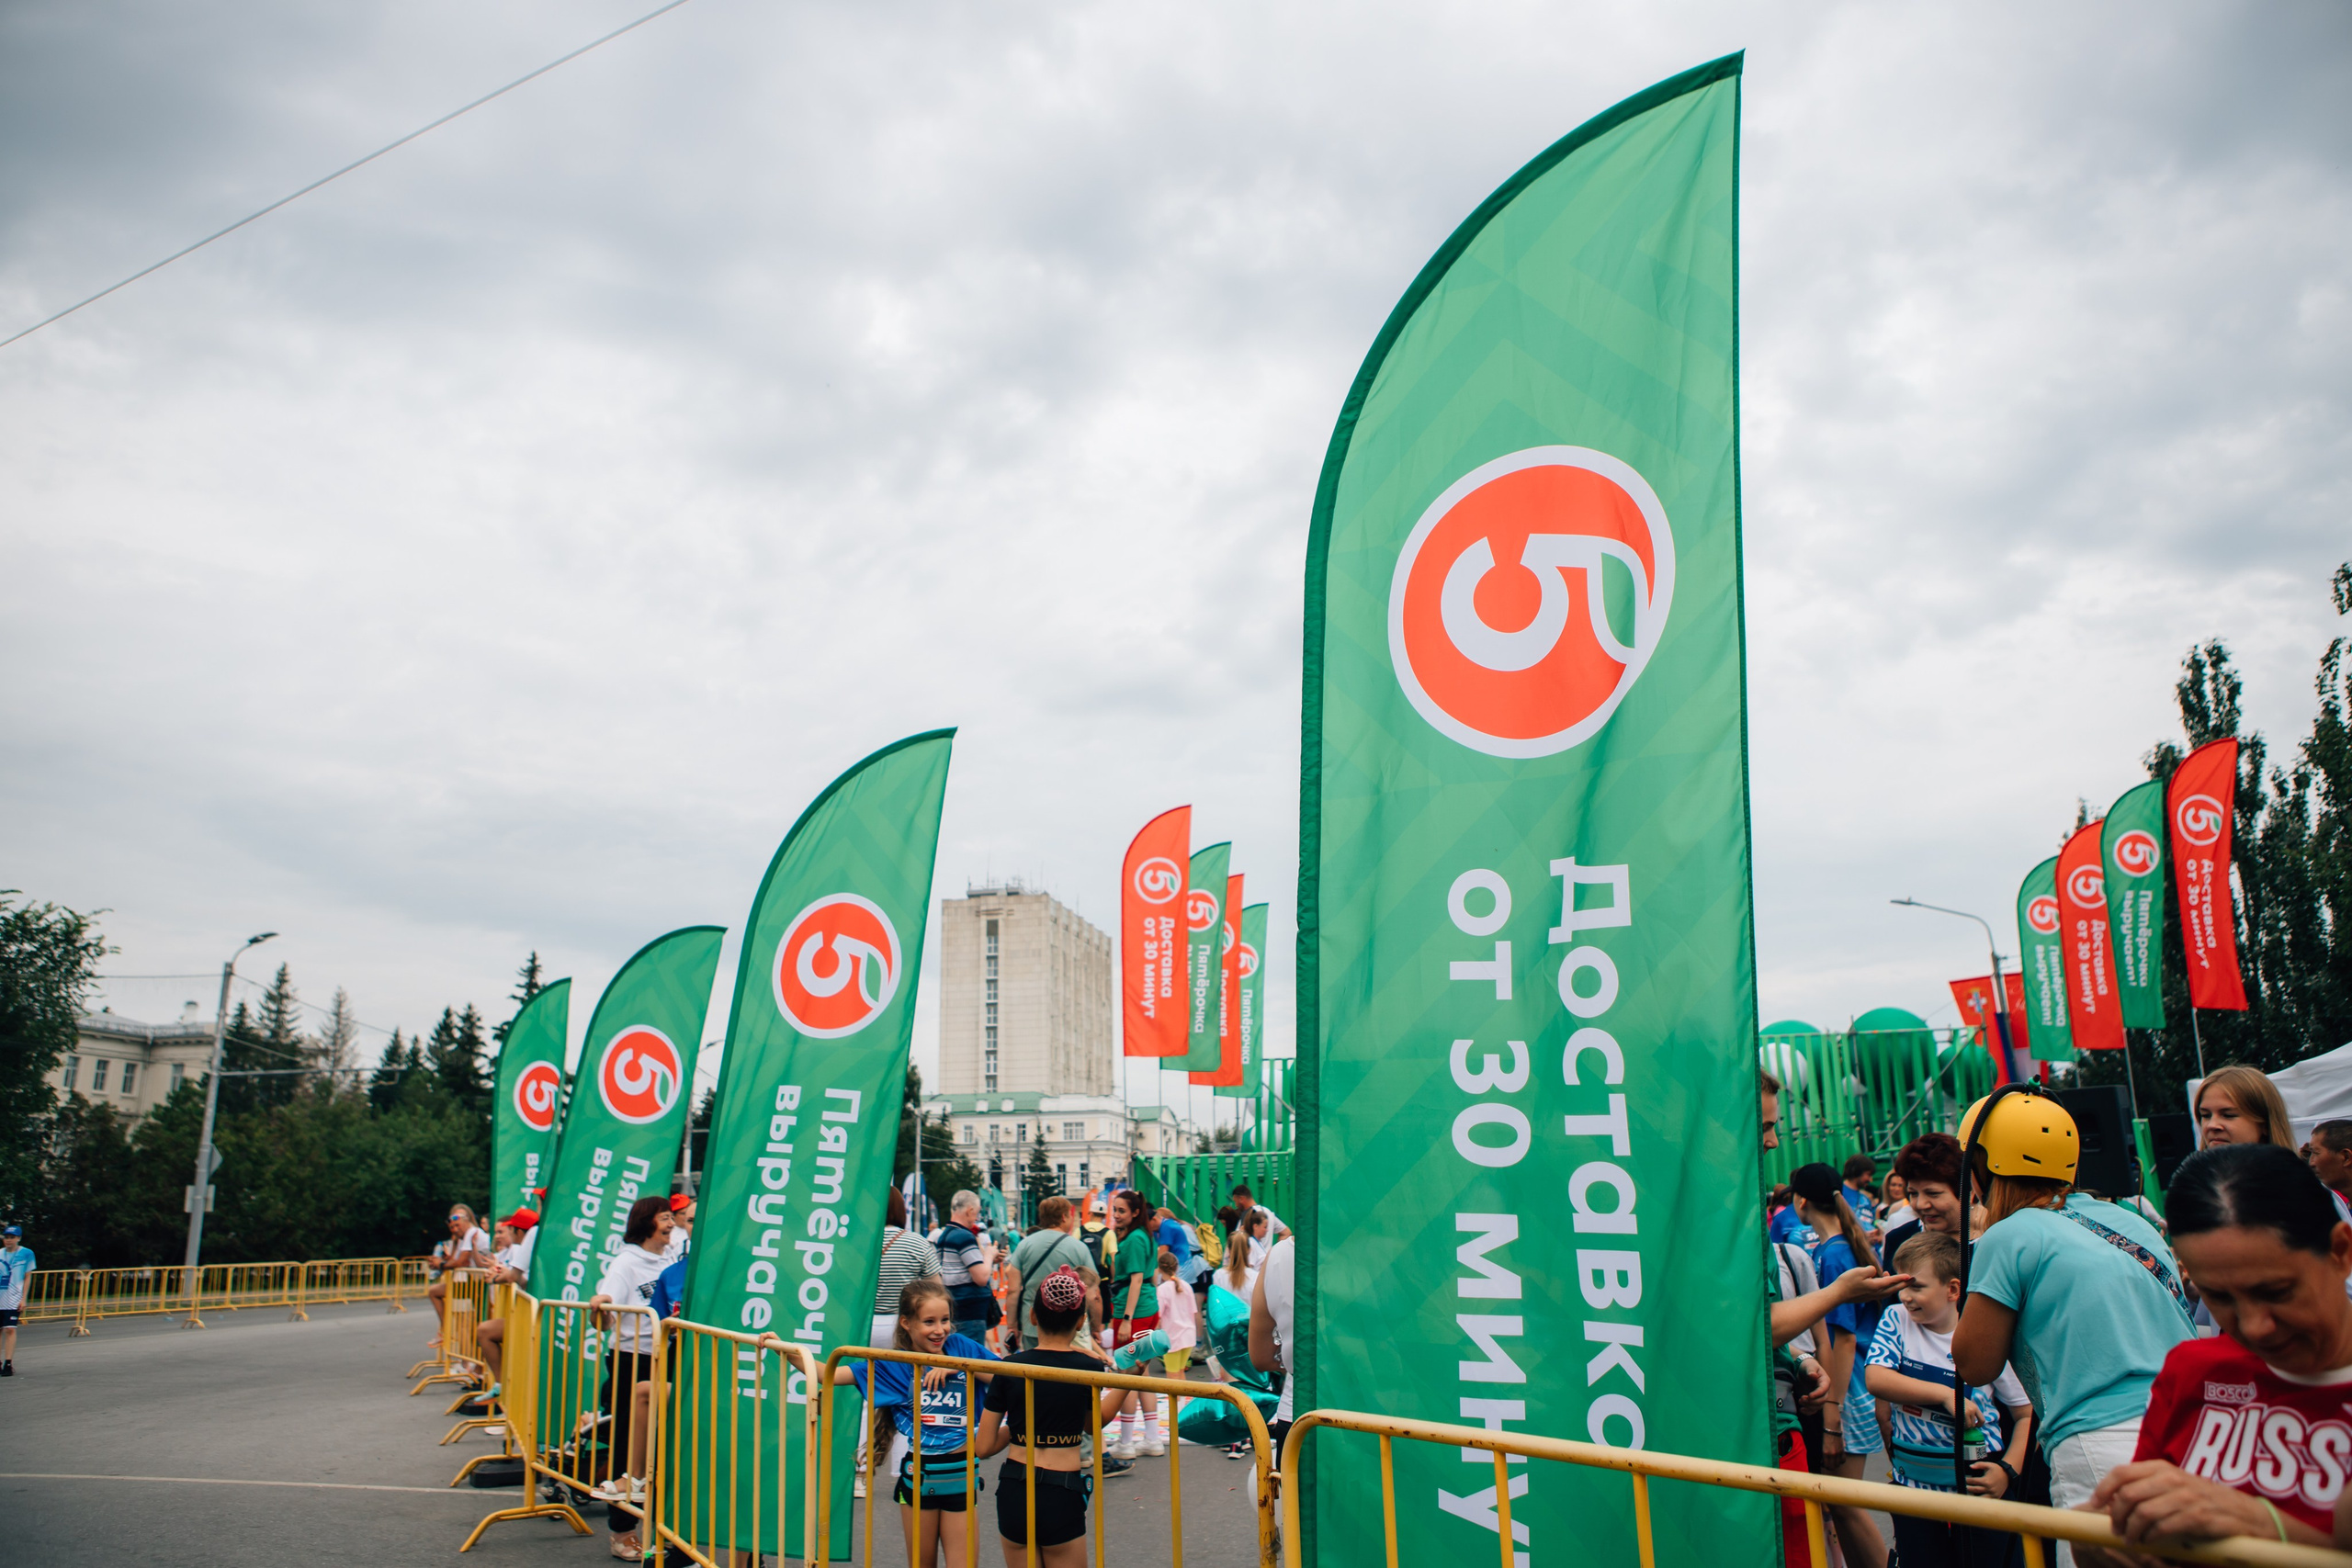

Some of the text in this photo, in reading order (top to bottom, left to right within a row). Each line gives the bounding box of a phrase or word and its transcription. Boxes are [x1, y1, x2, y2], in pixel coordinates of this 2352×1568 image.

[2120, 890, 2137, 987] выручает!
[2135, 890, 2153, 987] Пятёрочка
[2186, 859, 2211, 970] от 30 минут
[2200, 859, 2216, 949] Доставка
[1141, 917, 1159, 1019] от 30 минут
[1159, 916, 1175, 998] Доставка
[1194, 943, 1211, 1033] Пятёрочка
[2076, 919, 2097, 1014] от 30 минут
[2091, 919, 2108, 996] Доставка
[1240, 988, 1253, 1066] Пятёрочка
[1548, 856, 1645, 1451] Доставка
[1438, 868, 1532, 1568] от 30 мину
[921, 1390, 962, 1408] 6241
[2206, 1383, 2253, 1403] BOSCO
[1017, 1433, 1082, 1445] WLDWIN
